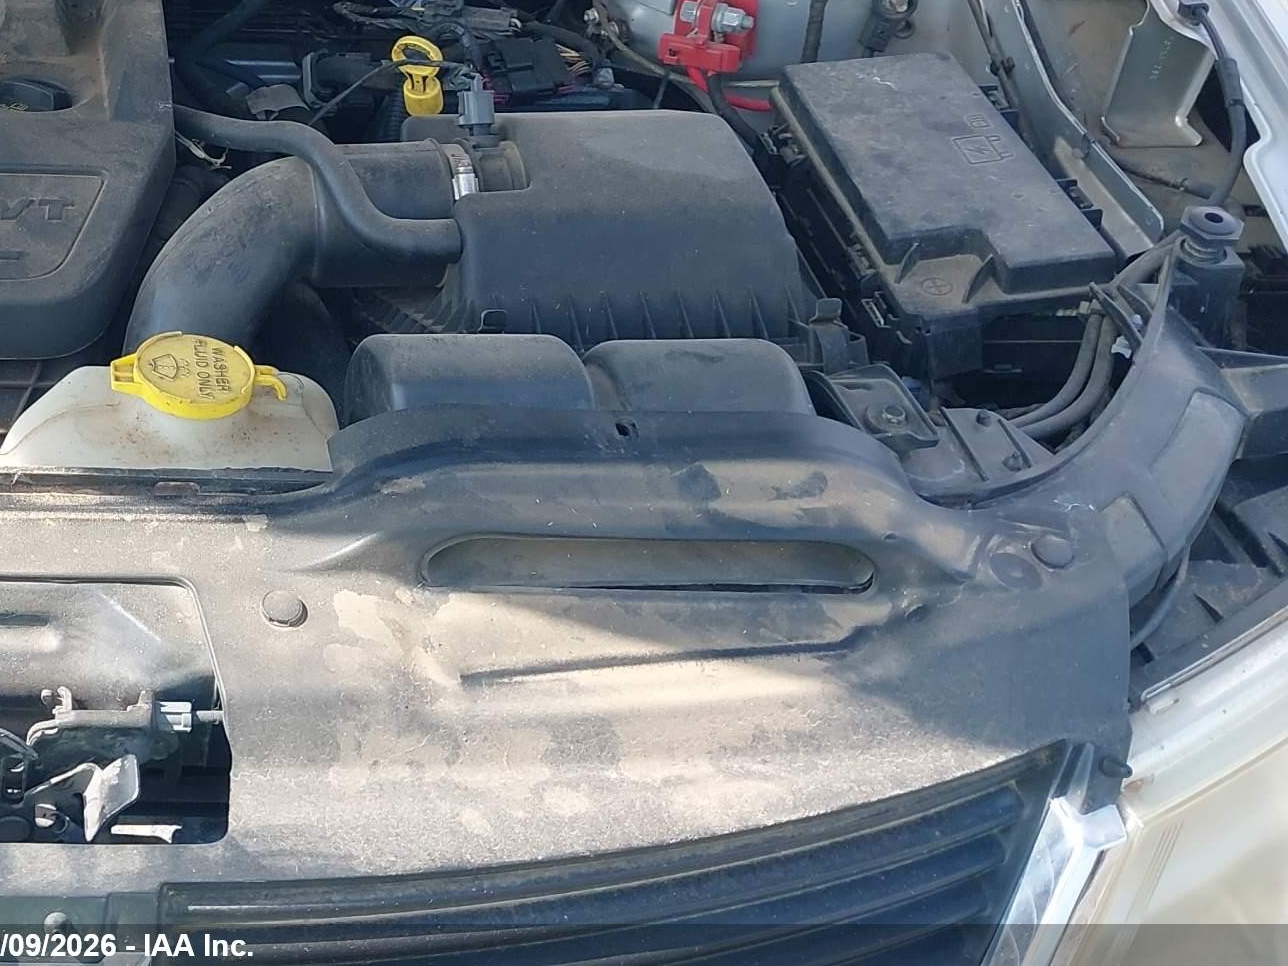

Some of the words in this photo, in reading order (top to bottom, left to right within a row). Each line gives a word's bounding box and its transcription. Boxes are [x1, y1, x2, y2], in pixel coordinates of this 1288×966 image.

[192, 338, 210, 369] FLUID
[212, 345, 233, 394] WASHER
[197, 370, 216, 402] ONLY
